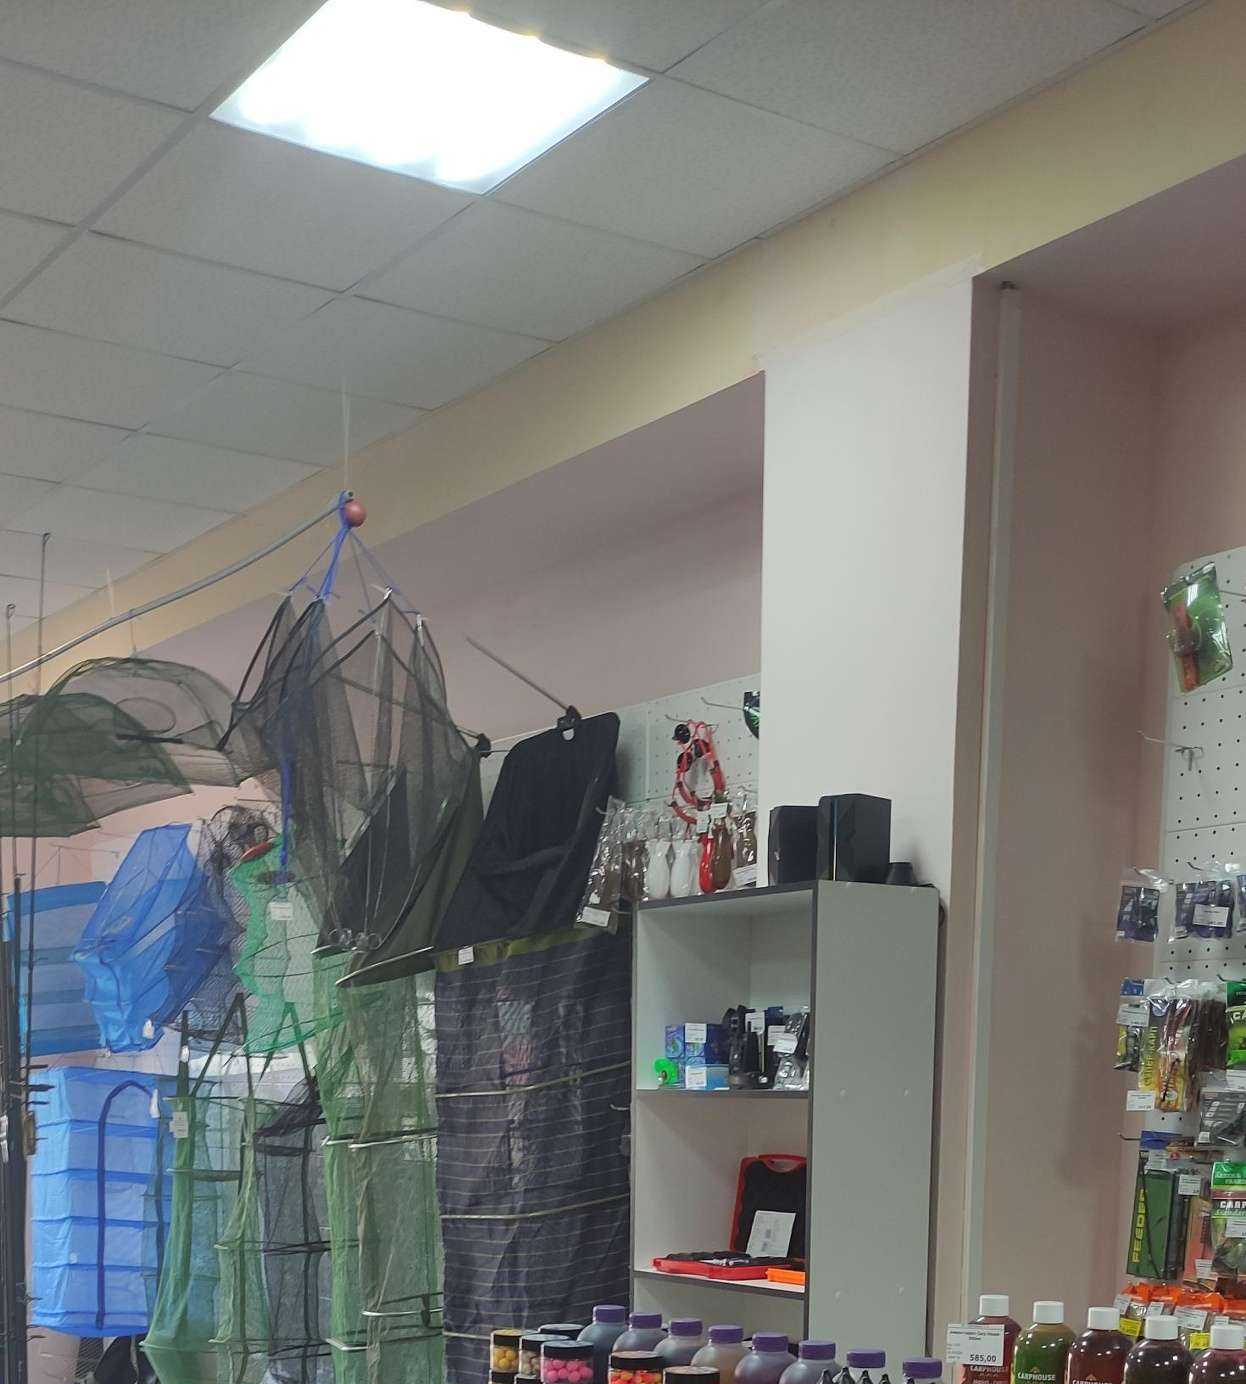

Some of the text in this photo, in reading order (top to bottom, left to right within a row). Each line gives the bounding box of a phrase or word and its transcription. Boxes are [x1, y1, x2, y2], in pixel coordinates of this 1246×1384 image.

[1131, 1189, 1147, 1263] FEEDER
[970, 1354, 996, 1362] 585,00
[1018, 1372, 1055, 1381] CARPHOUSE
